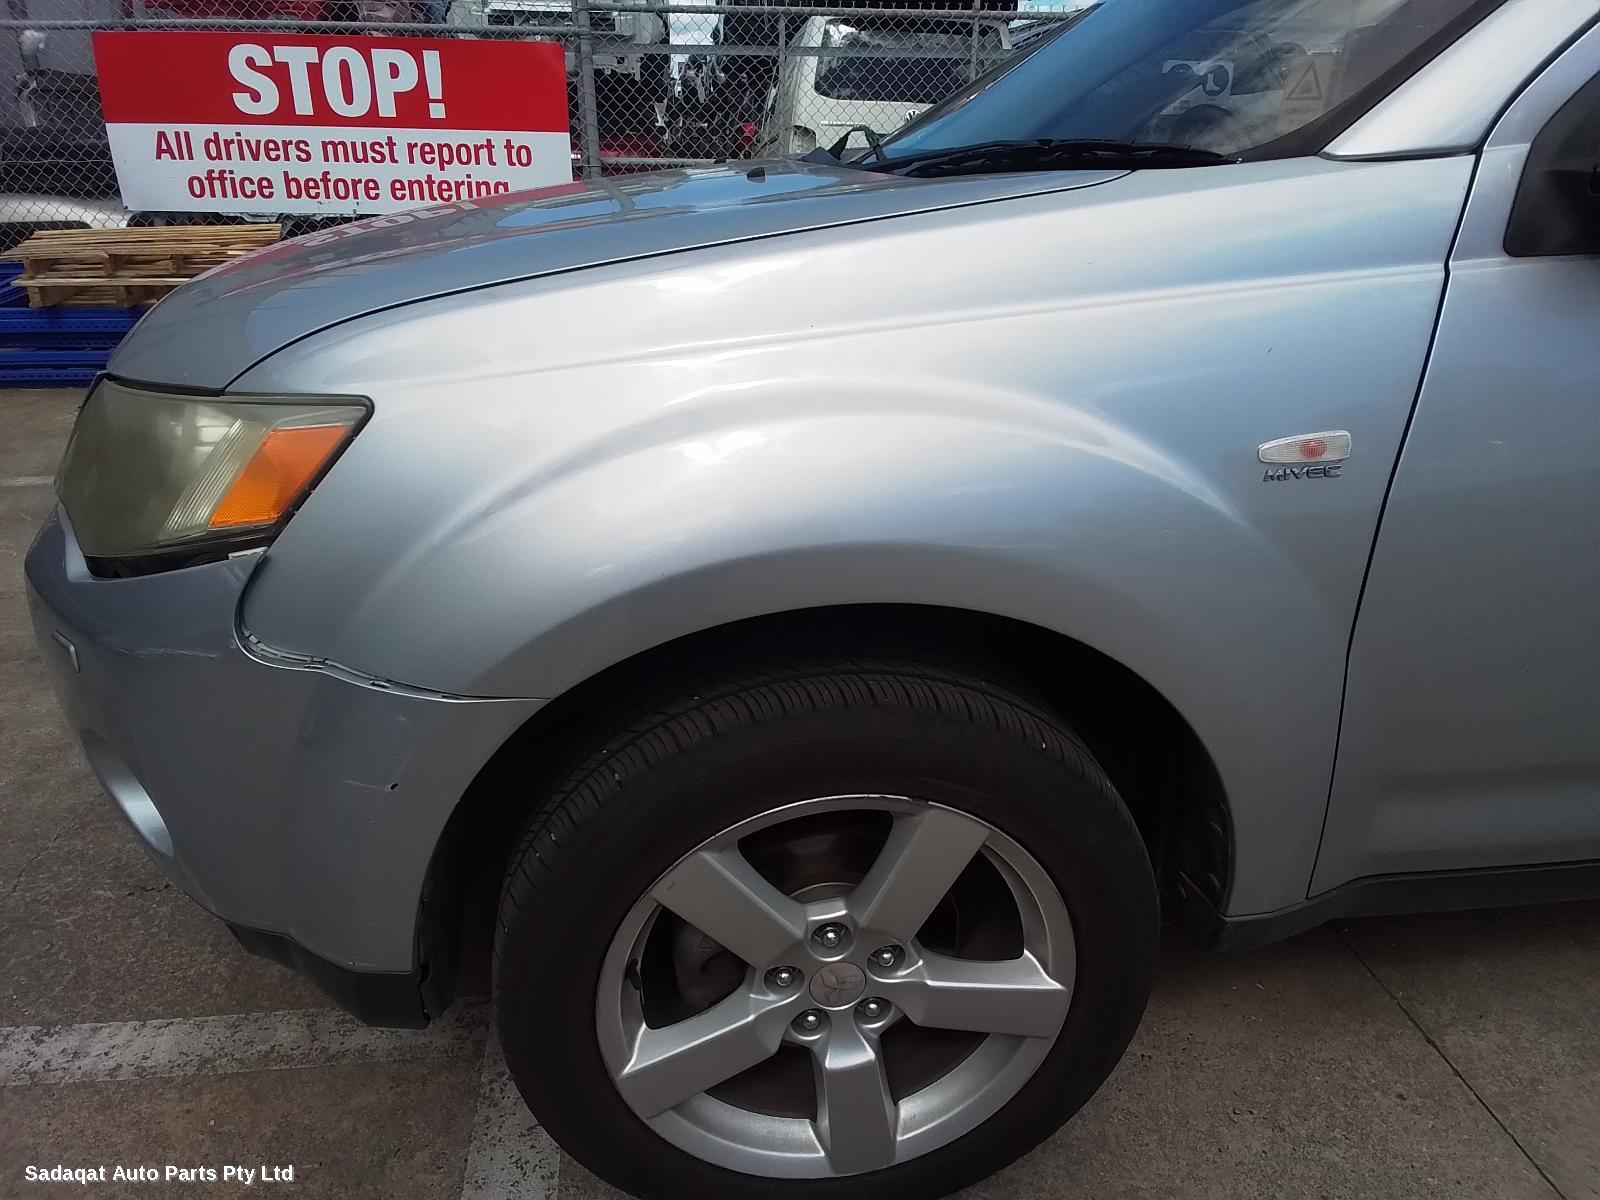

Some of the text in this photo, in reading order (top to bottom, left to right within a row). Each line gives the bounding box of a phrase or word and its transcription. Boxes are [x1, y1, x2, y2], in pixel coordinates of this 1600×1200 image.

[228, 43, 446, 119] STOP!
[155, 130, 533, 172] All drivers must report to
[187, 169, 275, 199] office
[282, 170, 381, 201] before
